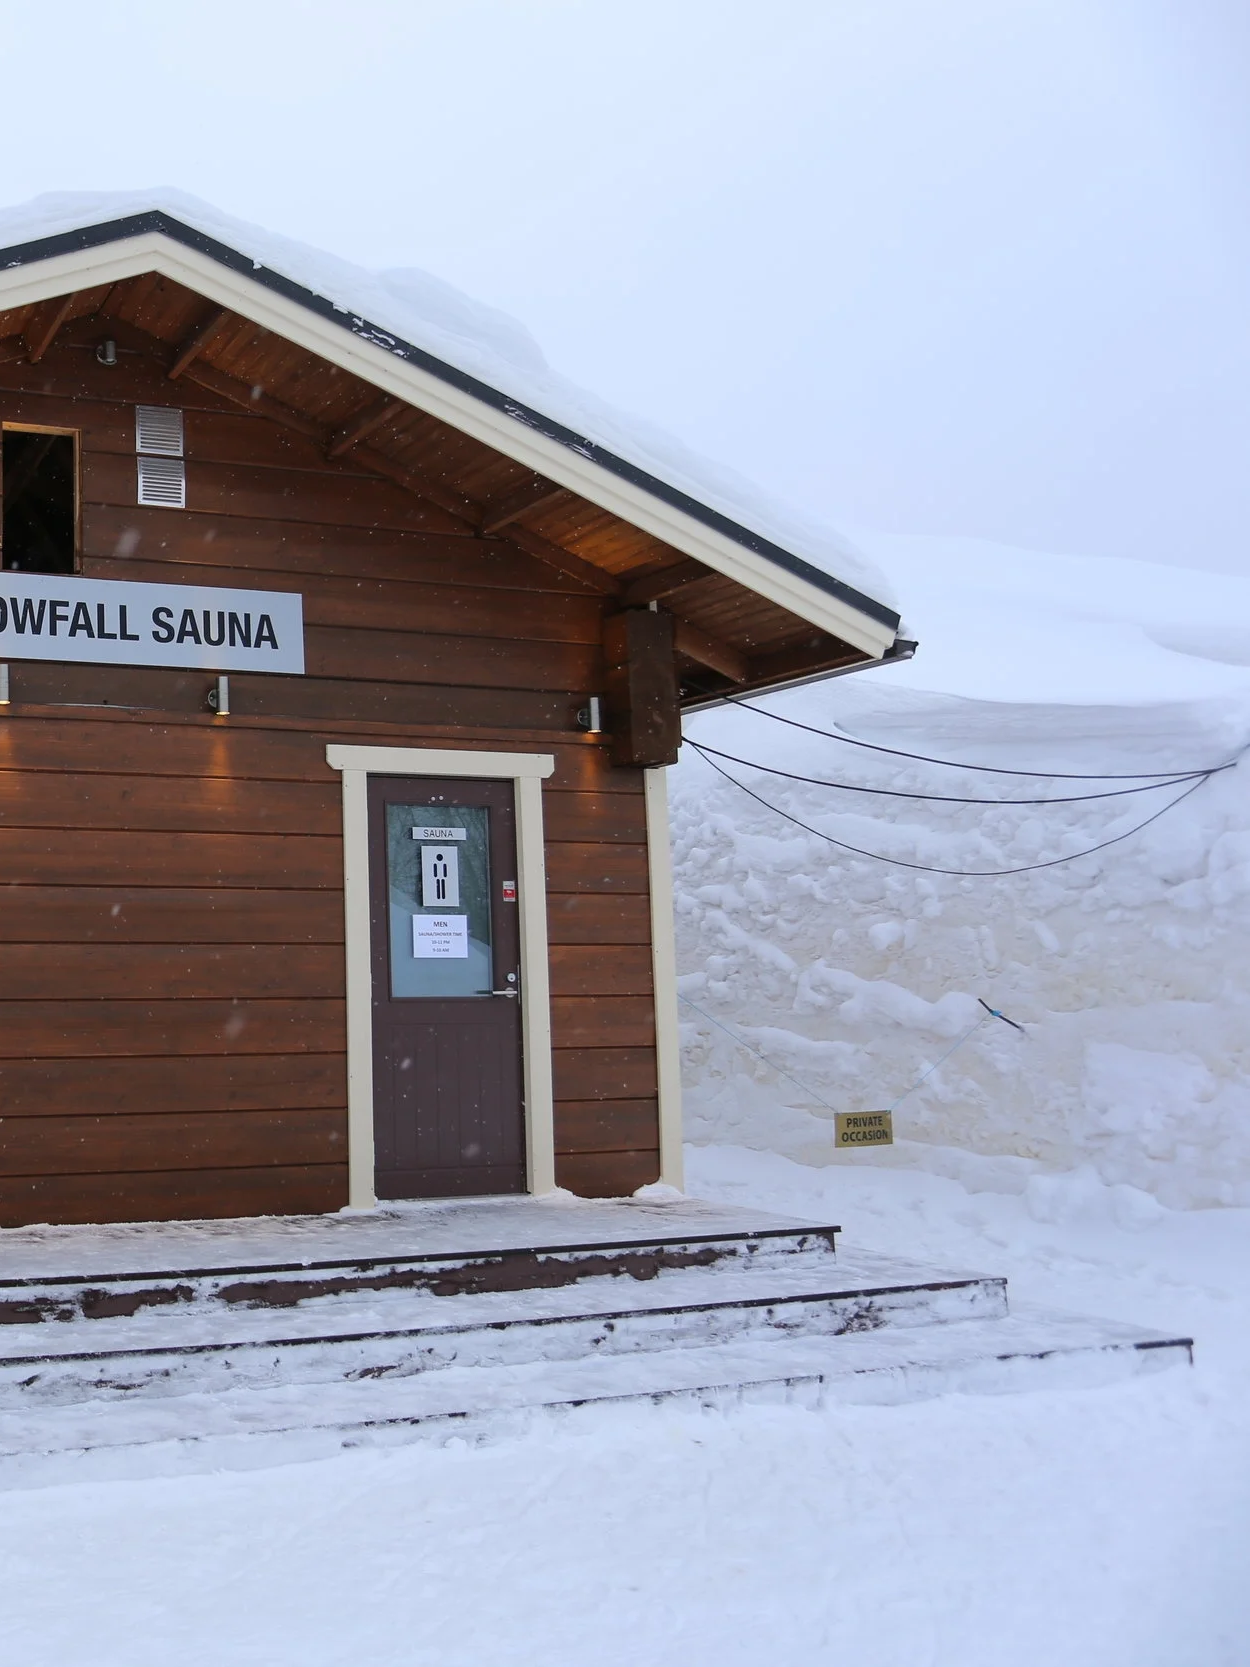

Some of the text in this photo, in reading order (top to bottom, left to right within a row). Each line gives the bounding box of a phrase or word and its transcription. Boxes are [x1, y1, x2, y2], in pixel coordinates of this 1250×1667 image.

[152, 606, 279, 650] SAUNA
[423, 829, 453, 838] SAUNA
[846, 1116, 883, 1128] PRIVATE
[841, 1129, 888, 1142] OCCASION
